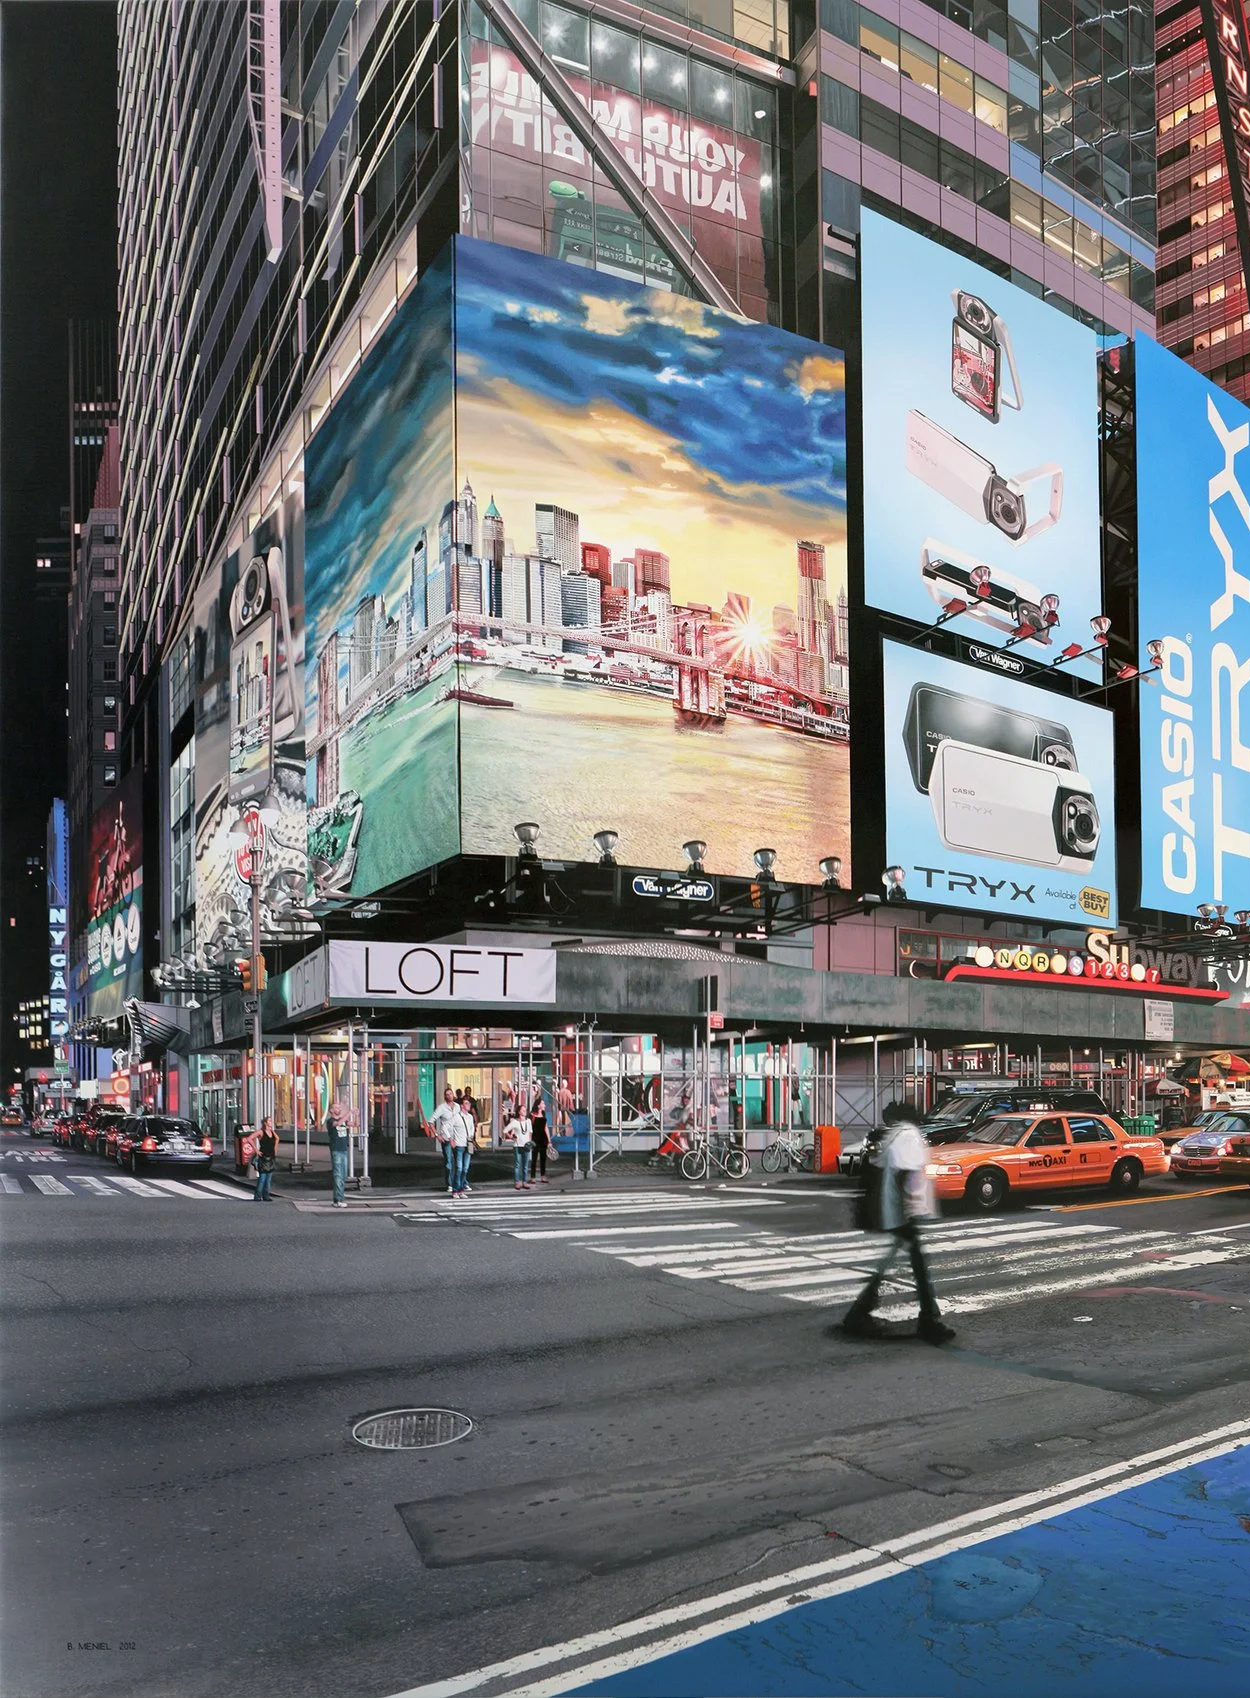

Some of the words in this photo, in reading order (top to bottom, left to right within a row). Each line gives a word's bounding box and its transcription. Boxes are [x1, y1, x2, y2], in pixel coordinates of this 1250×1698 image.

[991, 652, 1021, 672] Wagner
[1161, 636, 1197, 896] CASIO
[952, 787, 975, 796] CASIO
[667, 885, 708, 898] agner
[914, 866, 1036, 904] TRYX
[1045, 888, 1077, 900] Available
[1083, 891, 1109, 906] BEST
[1083, 901, 1107, 913] BUY
[1000, 953, 1010, 964] N
[1019, 953, 1029, 967] Q
[1037, 957, 1046, 968] R
[1073, 960, 1081, 973] S
[1089, 962, 1096, 974] 1
[1105, 963, 1113, 977] 2
[1120, 964, 1129, 978] 3
[1151, 971, 1157, 982] 7
[1087, 932, 1201, 988] Subway
[365, 946, 524, 997] LOFT
[291, 954, 319, 1011] LOFT
[1043, 1154, 1067, 1168] TAXI
[79, 1642, 112, 1650] MENIEL
[119, 1642, 136, 1650] 2012
